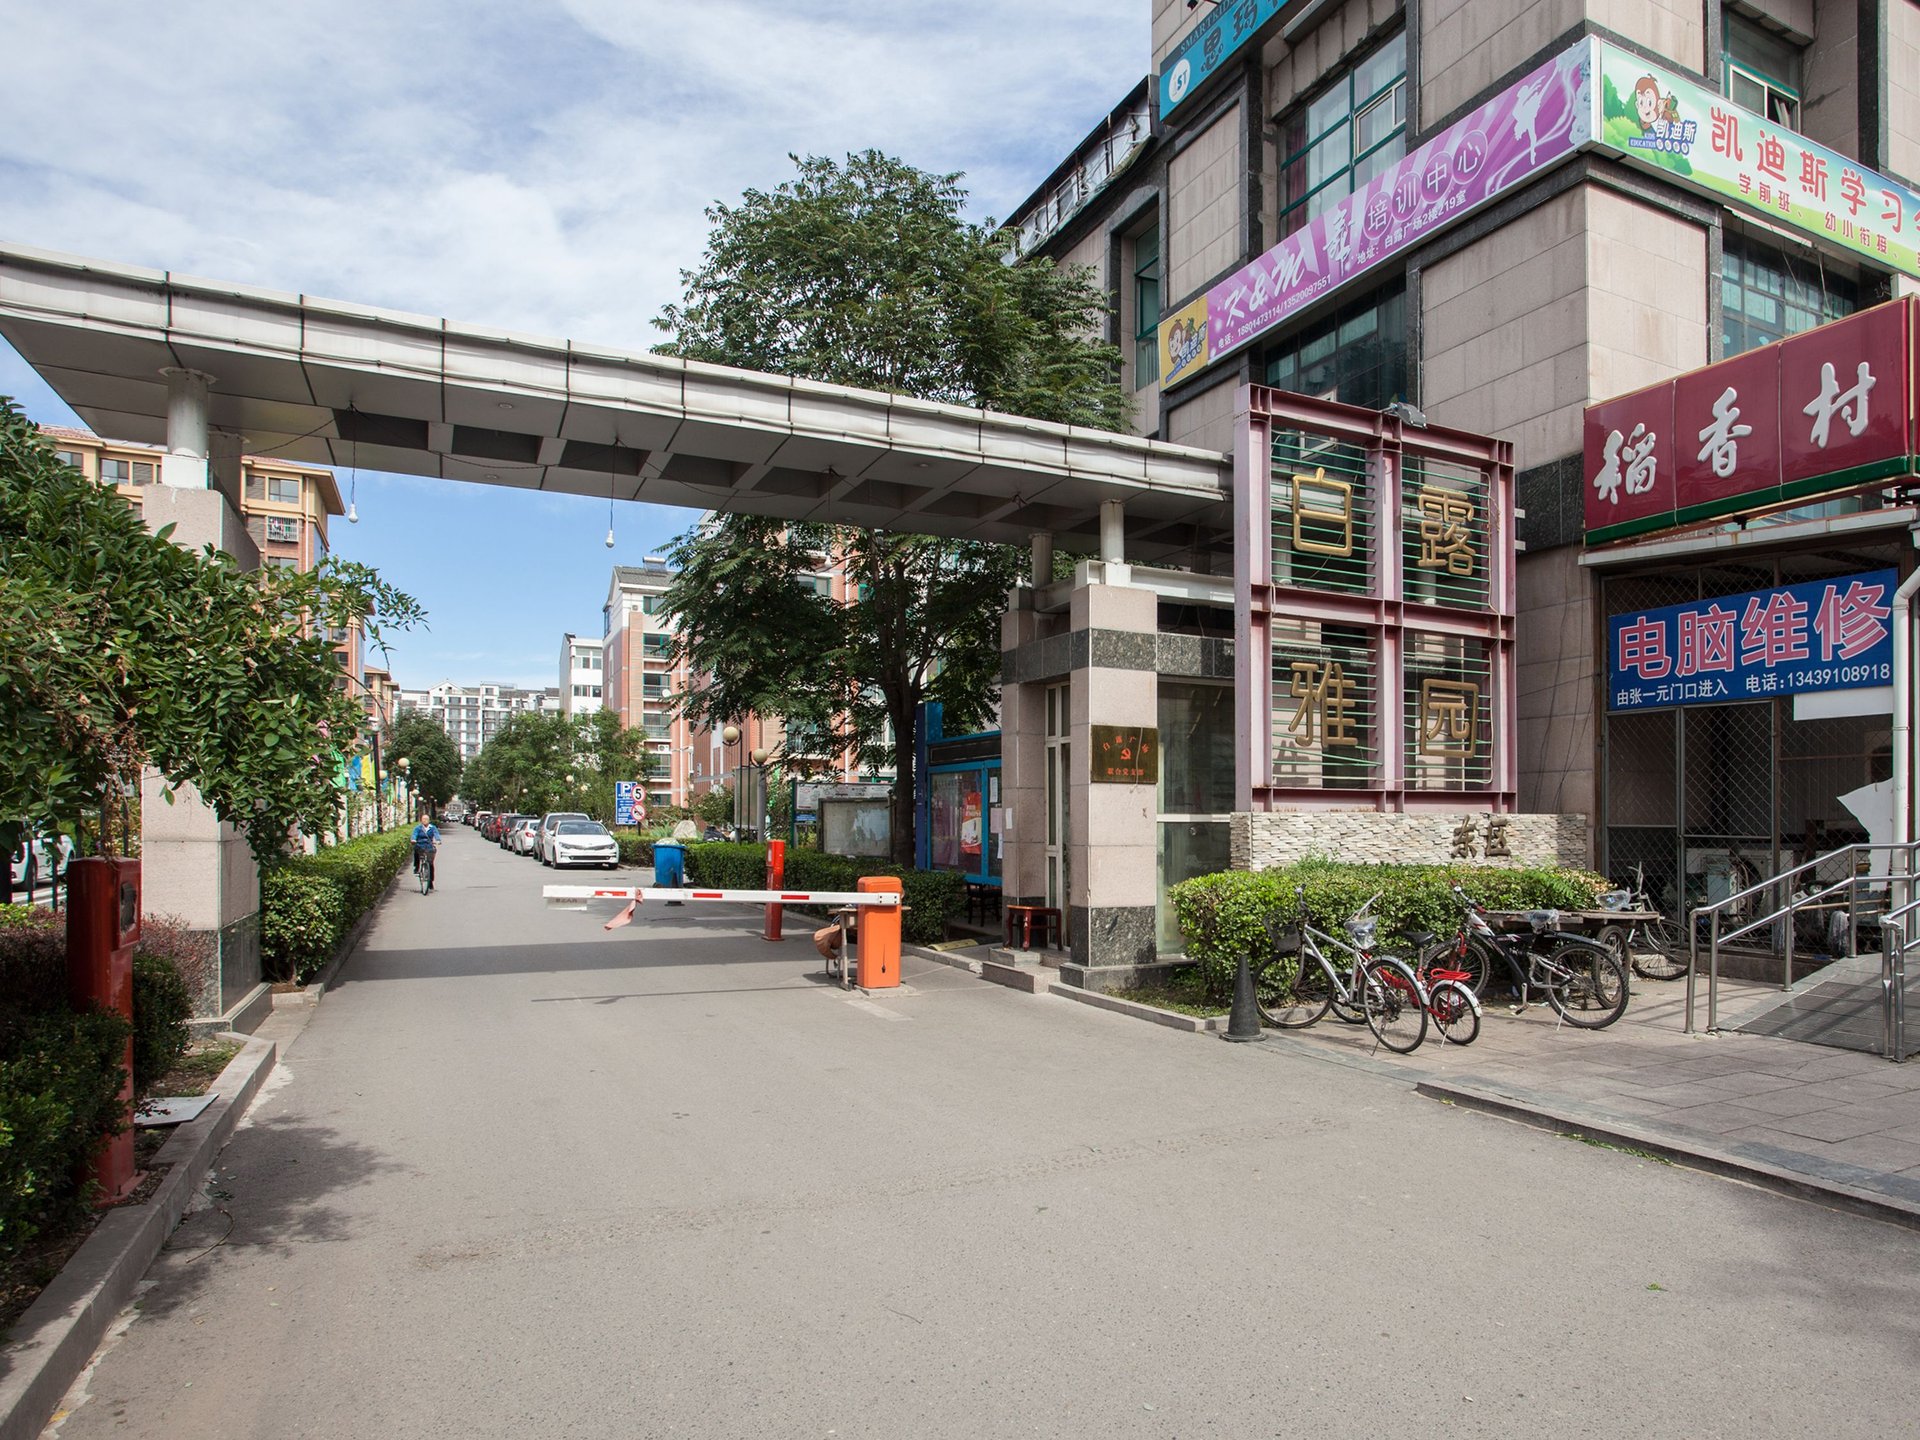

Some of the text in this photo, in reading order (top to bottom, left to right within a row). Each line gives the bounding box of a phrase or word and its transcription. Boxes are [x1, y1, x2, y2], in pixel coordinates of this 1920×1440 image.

[1201, 0, 1279, 73] 思玛
[1368, 142, 1481, 231] 培训中心
[1710, 106, 1920, 233] 凯迪斯学习
[1593, 361, 1877, 505] 稻香村
[1292, 467, 1477, 576] 白露
[1618, 580, 1891, 680] 电脑维修
[1288, 661, 1480, 759] 雅园
[1617, 678, 1728, 706] 由张一元门口进入
[635, 788, 642, 800] 5
